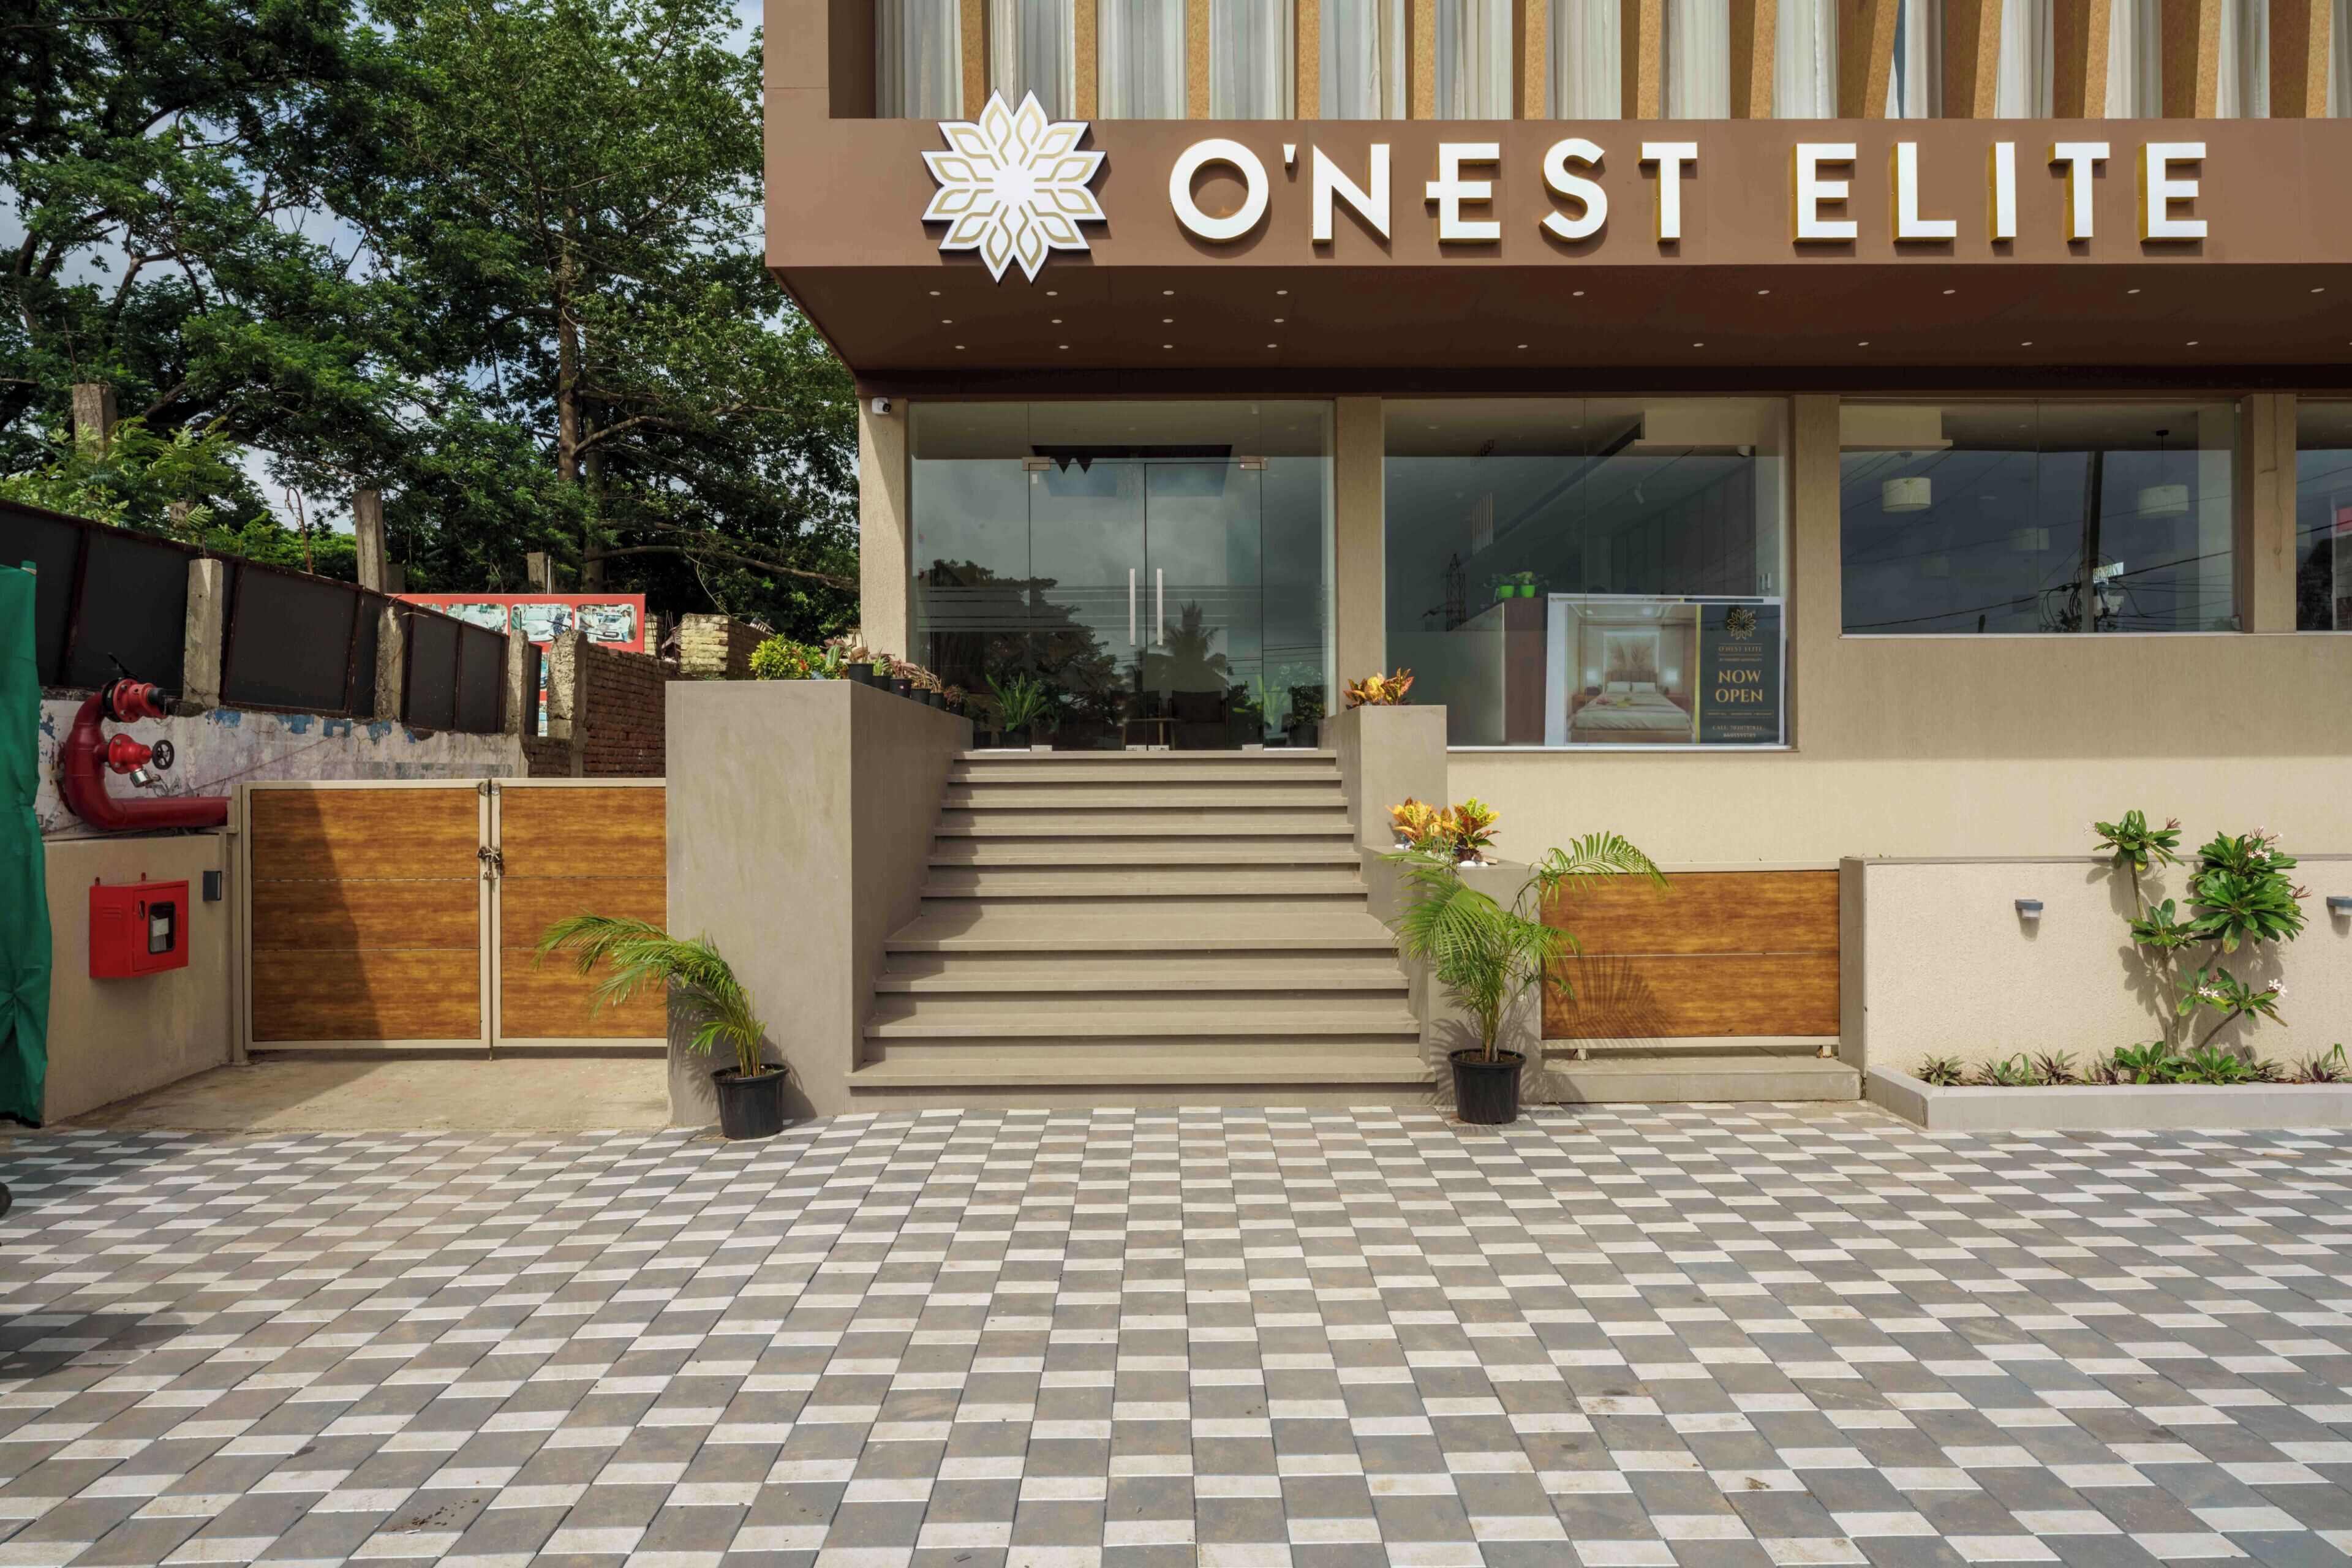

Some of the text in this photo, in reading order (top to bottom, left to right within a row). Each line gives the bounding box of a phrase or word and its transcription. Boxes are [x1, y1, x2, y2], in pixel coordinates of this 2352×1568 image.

[1169, 138, 2207, 241] O'NEST ELITE
[1718, 669, 1762, 684] NOW
[1715, 688, 1763, 703] OPEN
